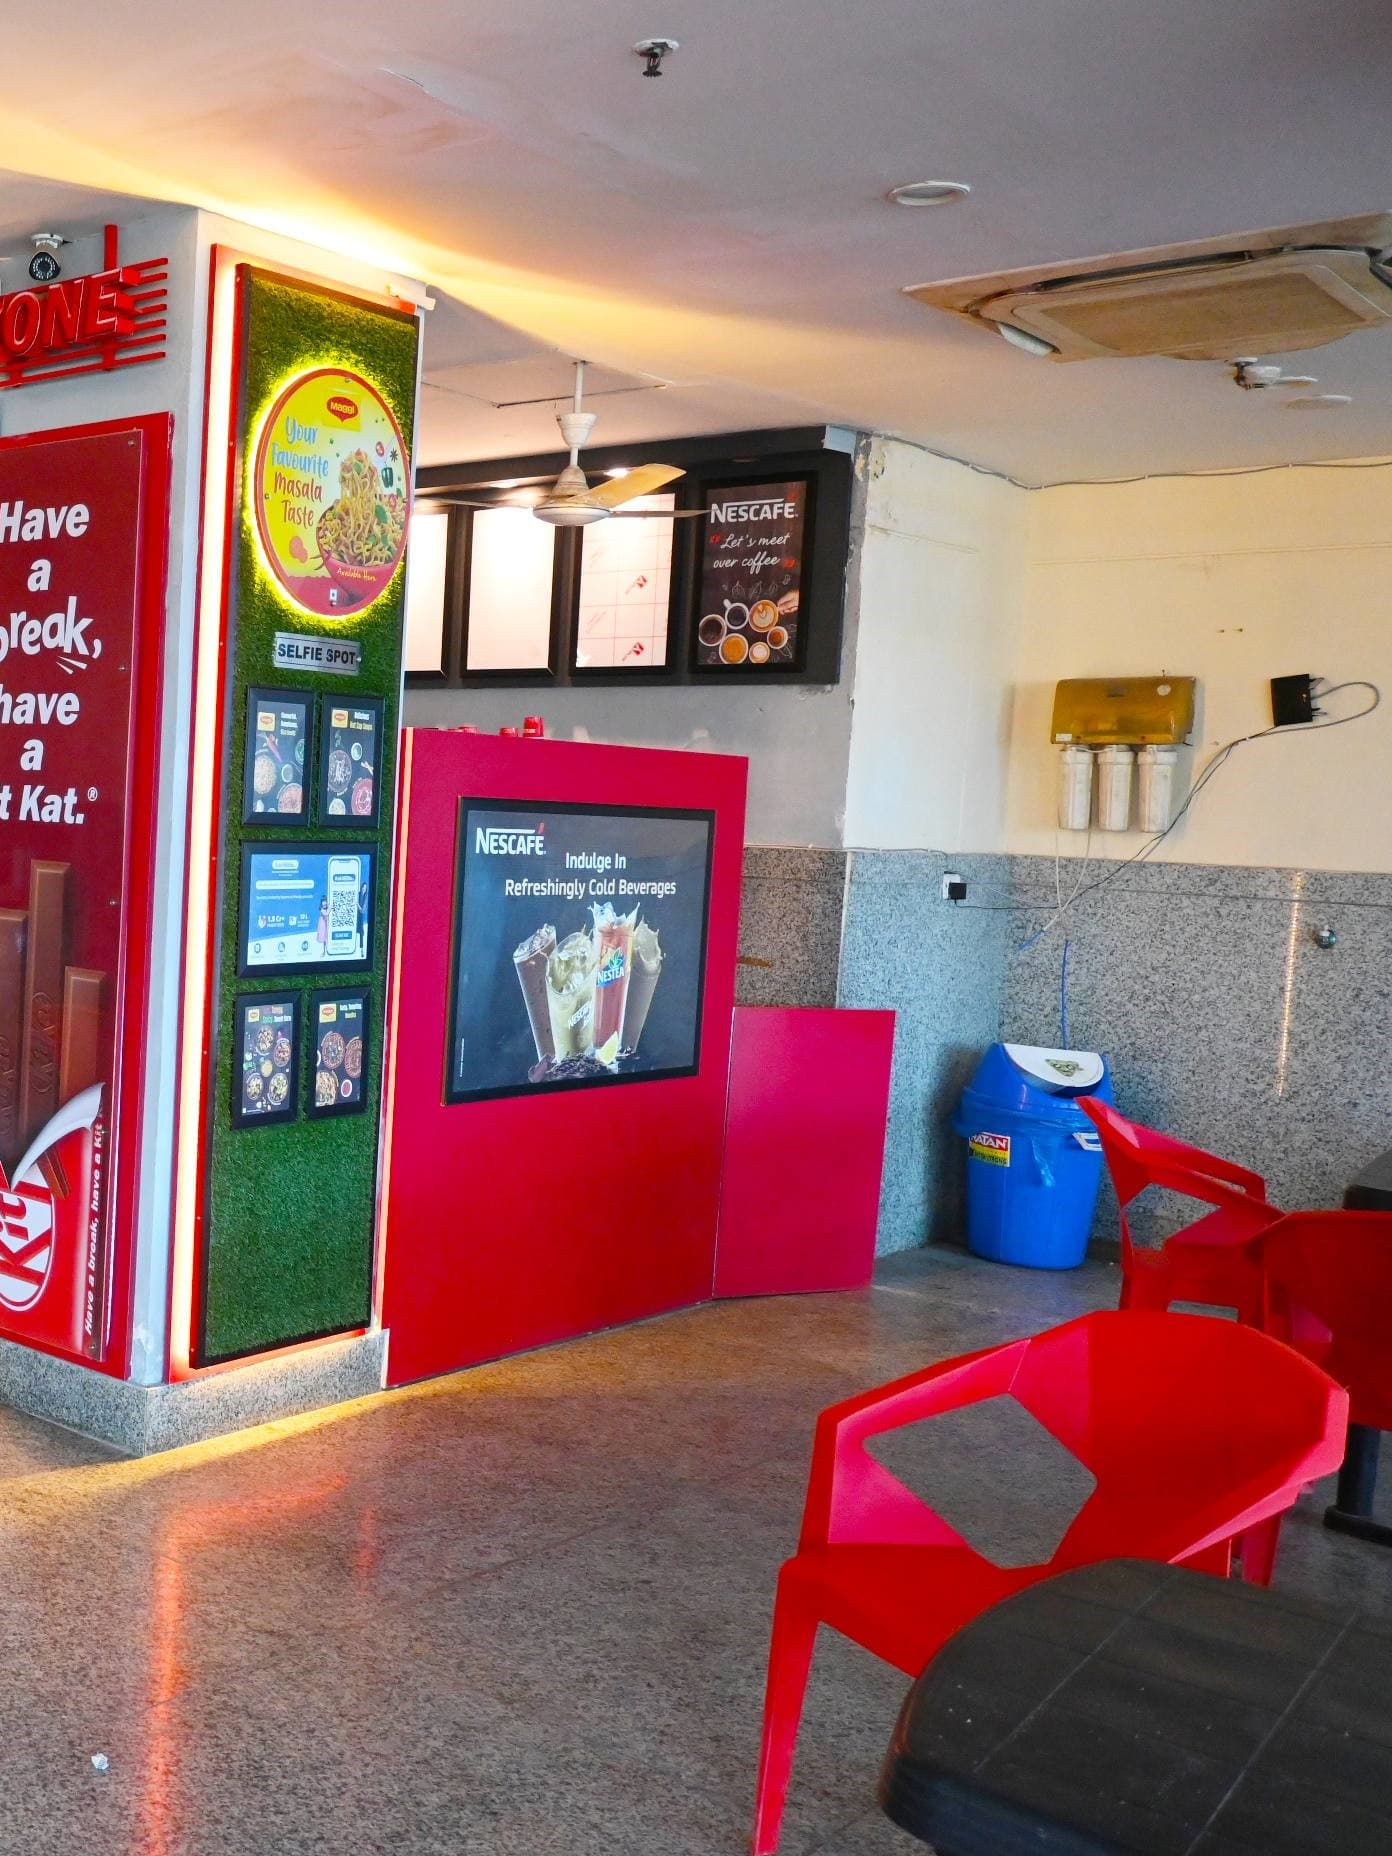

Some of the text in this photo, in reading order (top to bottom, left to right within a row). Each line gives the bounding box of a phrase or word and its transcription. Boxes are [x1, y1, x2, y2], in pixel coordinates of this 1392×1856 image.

[330, 402, 355, 415] Maggi
[285, 415, 318, 445] Your
[271, 442, 329, 479] Favourite
[274, 471, 323, 502] Masala
[281, 499, 314, 529] Taste
[758, 532, 790, 546] meet
[27, 558, 52, 592] a
[713, 550, 781, 575] over coffee
[278, 643, 356, 665] SELFIE SPOT
[20, 738, 44, 772] a
[565, 852, 627, 873] Indulge In
[505, 878, 676, 899] Refreshingly Cold Beverages
[597, 966, 624, 984] NESTEA
[85, 1291, 95, 1335] Have
[91, 1169, 100, 1212] have
